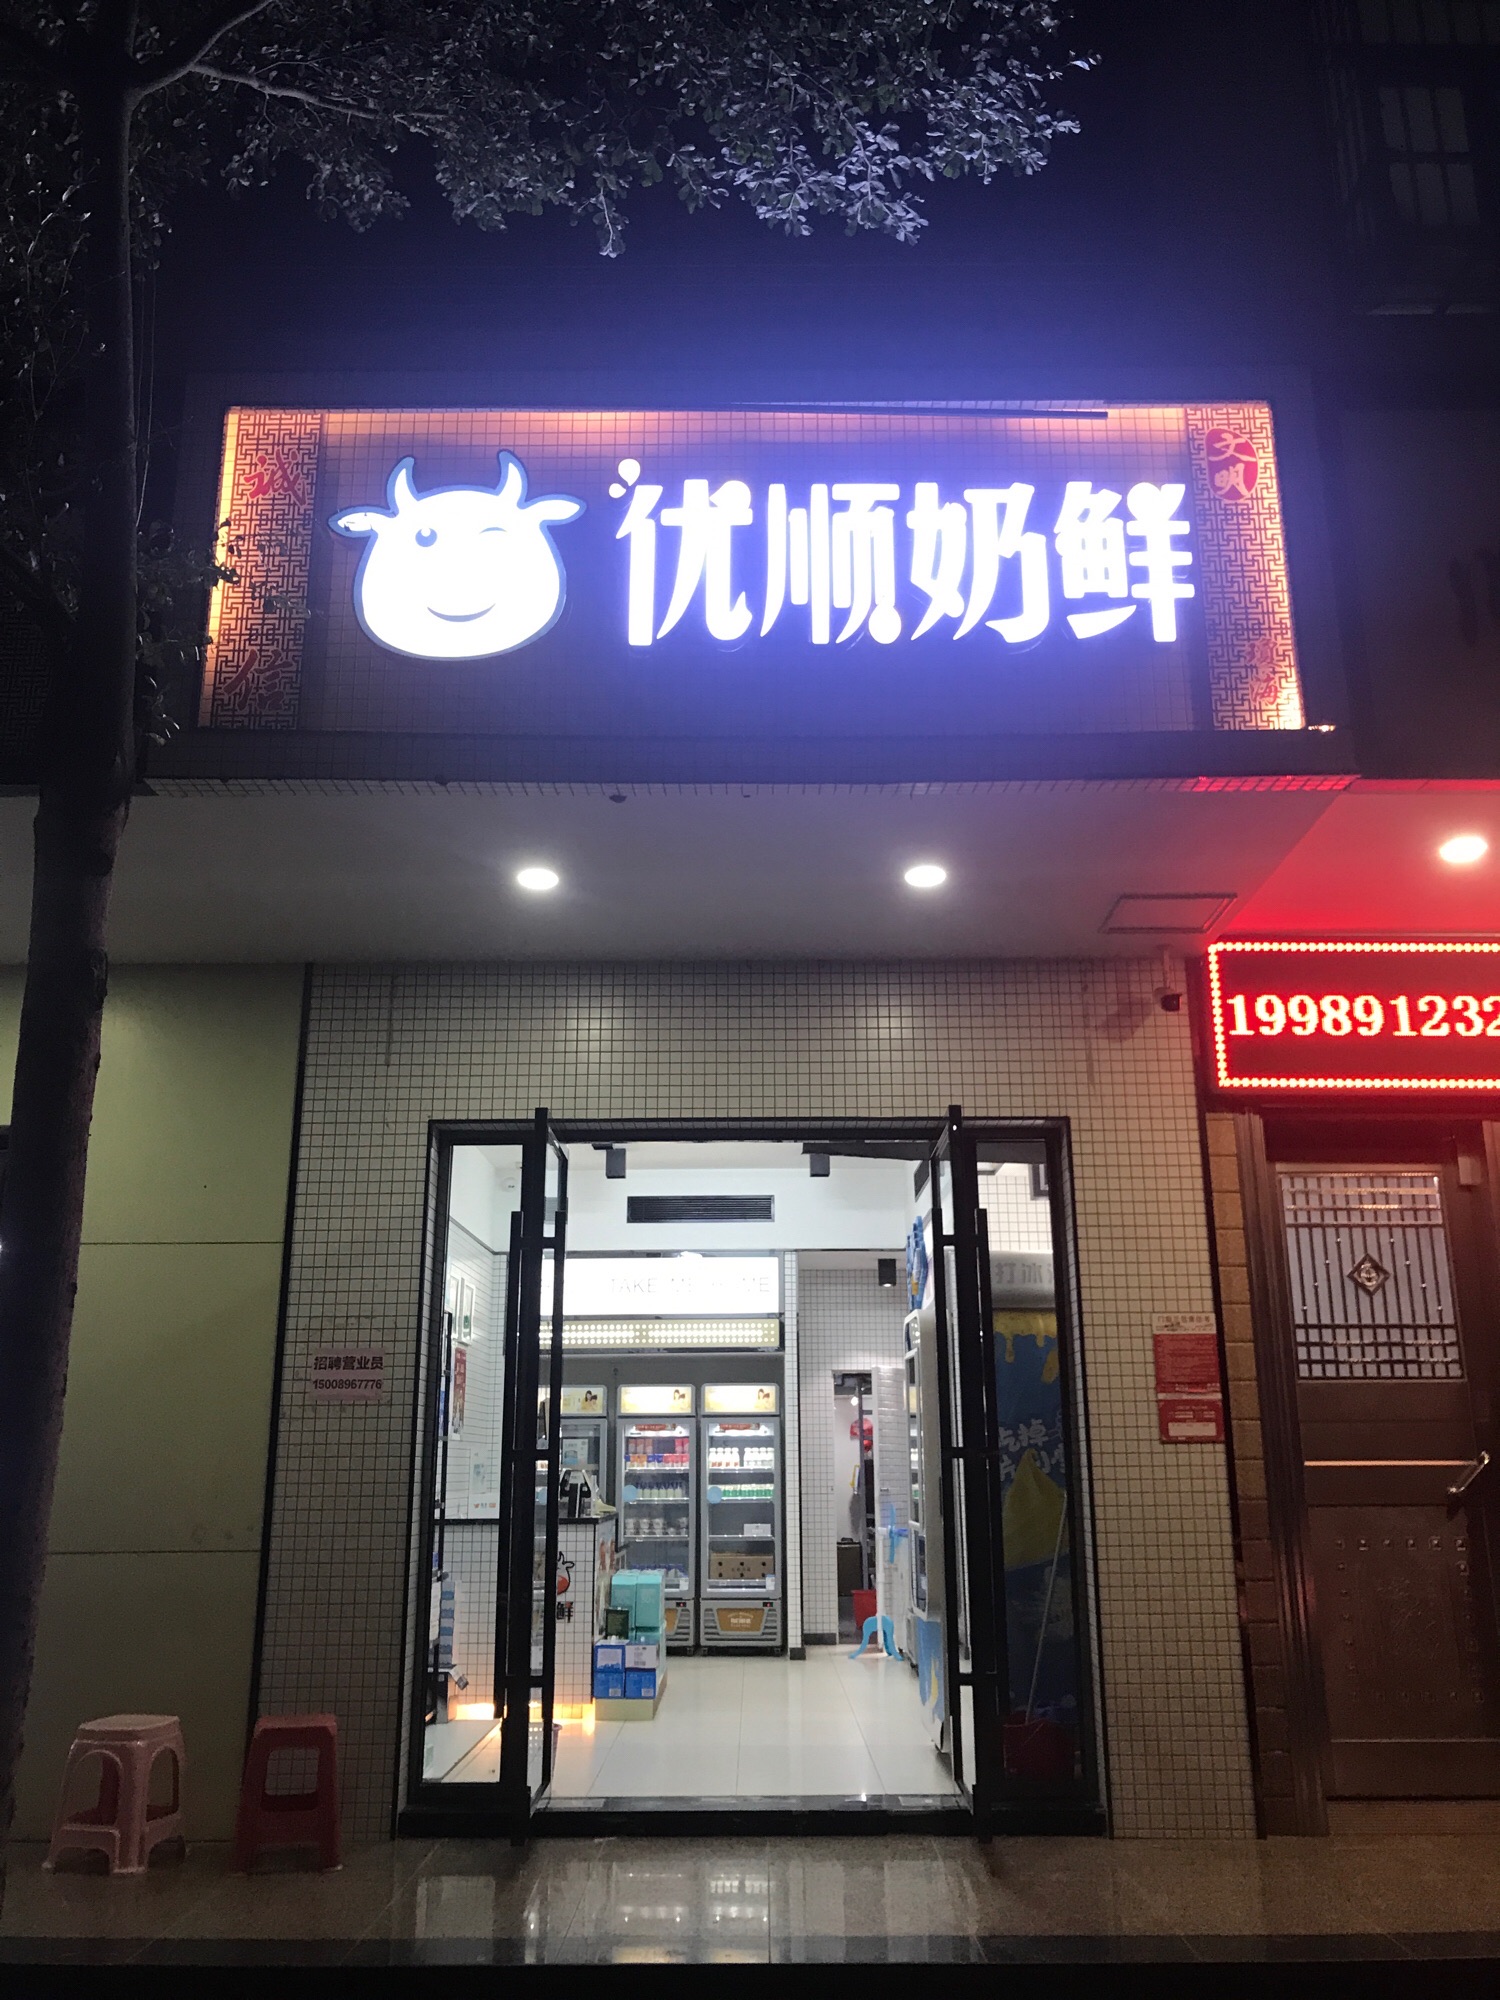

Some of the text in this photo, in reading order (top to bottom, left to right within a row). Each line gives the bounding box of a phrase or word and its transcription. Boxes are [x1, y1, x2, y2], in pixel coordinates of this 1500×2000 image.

[1208, 432, 1257, 496] 文明
[615, 478, 1196, 646] 优顺奶鲜
[995, 1262, 1053, 1284] 打冰
[313, 1355, 384, 1371] 招聘营业员
[312, 1379, 383, 1390] 15008967776
